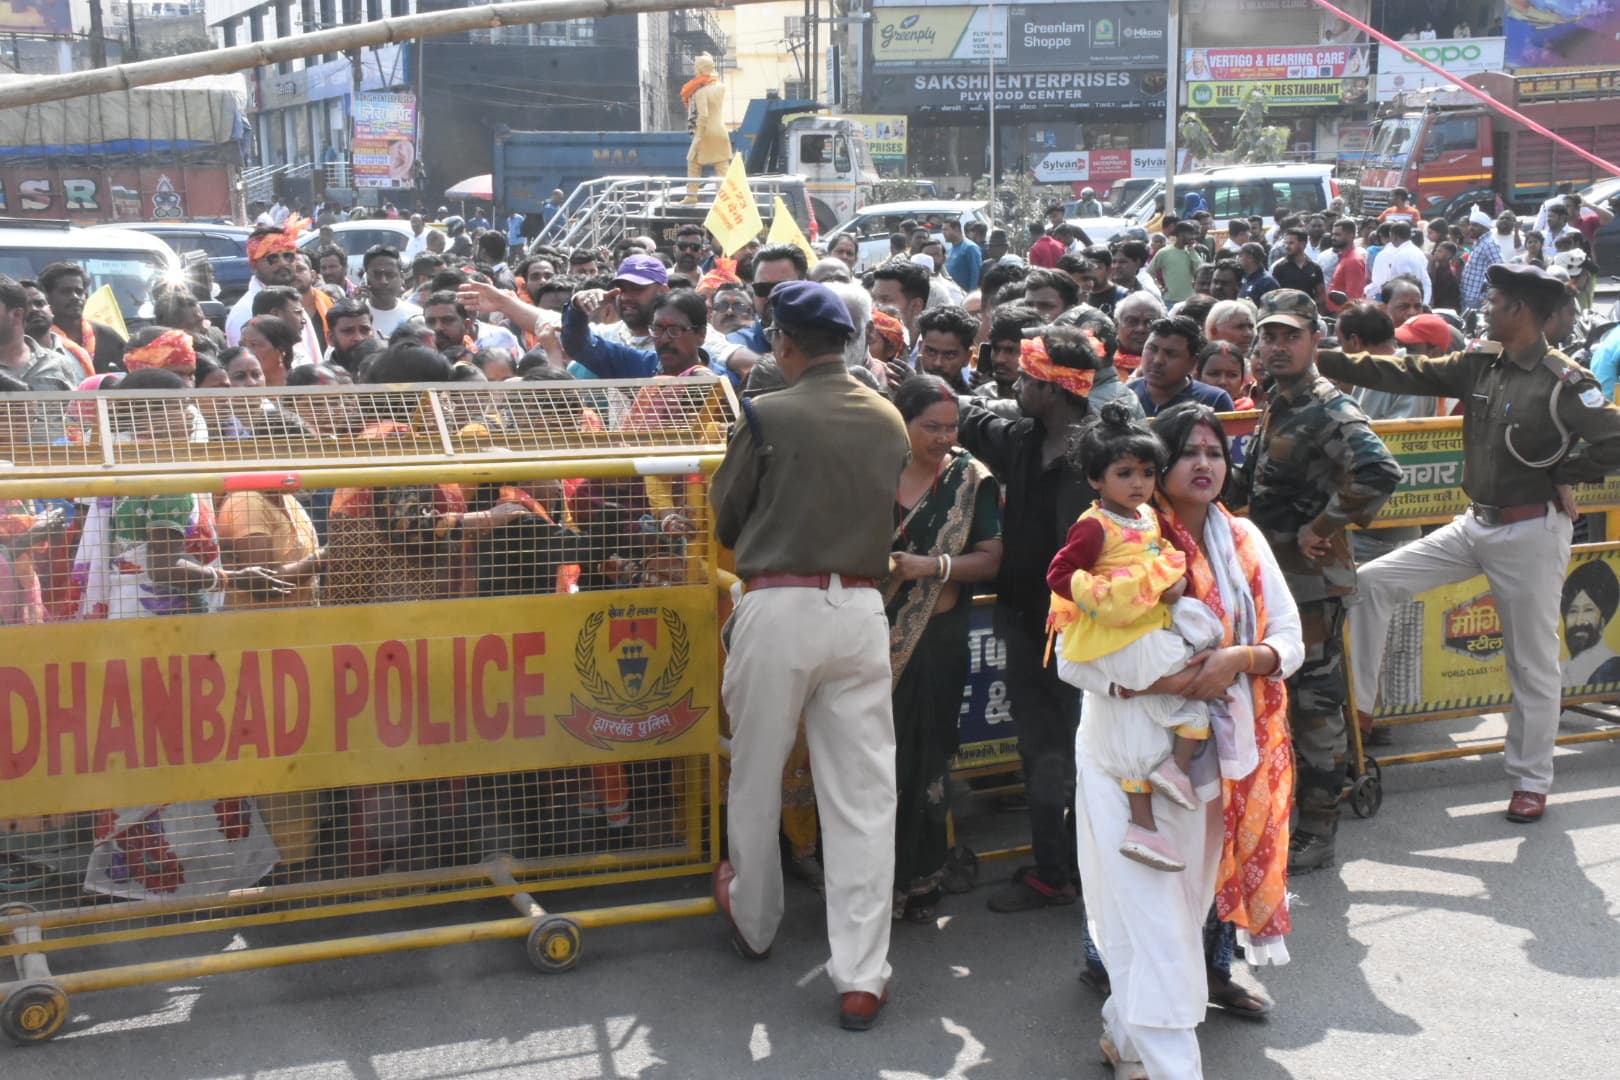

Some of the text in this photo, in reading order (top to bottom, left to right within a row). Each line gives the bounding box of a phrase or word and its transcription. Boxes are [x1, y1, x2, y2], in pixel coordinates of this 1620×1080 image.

[1024, 21, 1085, 34] Greenlam
[880, 24, 936, 48] Greenply
[1024, 36, 1071, 49] Shoppe
[1209, 52, 1345, 67] VERTIGO & HEARING CARE
[1402, 45, 1481, 66] oppo
[914, 74, 988, 90] SAKSHI
[995, 72, 1130, 89] ENTERPRISES
[960, 90, 1082, 101] PLYWOOD CENTER
[1216, 86, 1234, 97] THE
[1274, 83, 1340, 96] RESTAURANT
[866, 143, 904, 154] PRISES
[1441, 669, 1466, 678] WORLD
[0, 631, 546, 781] DHANBAD POLICE
